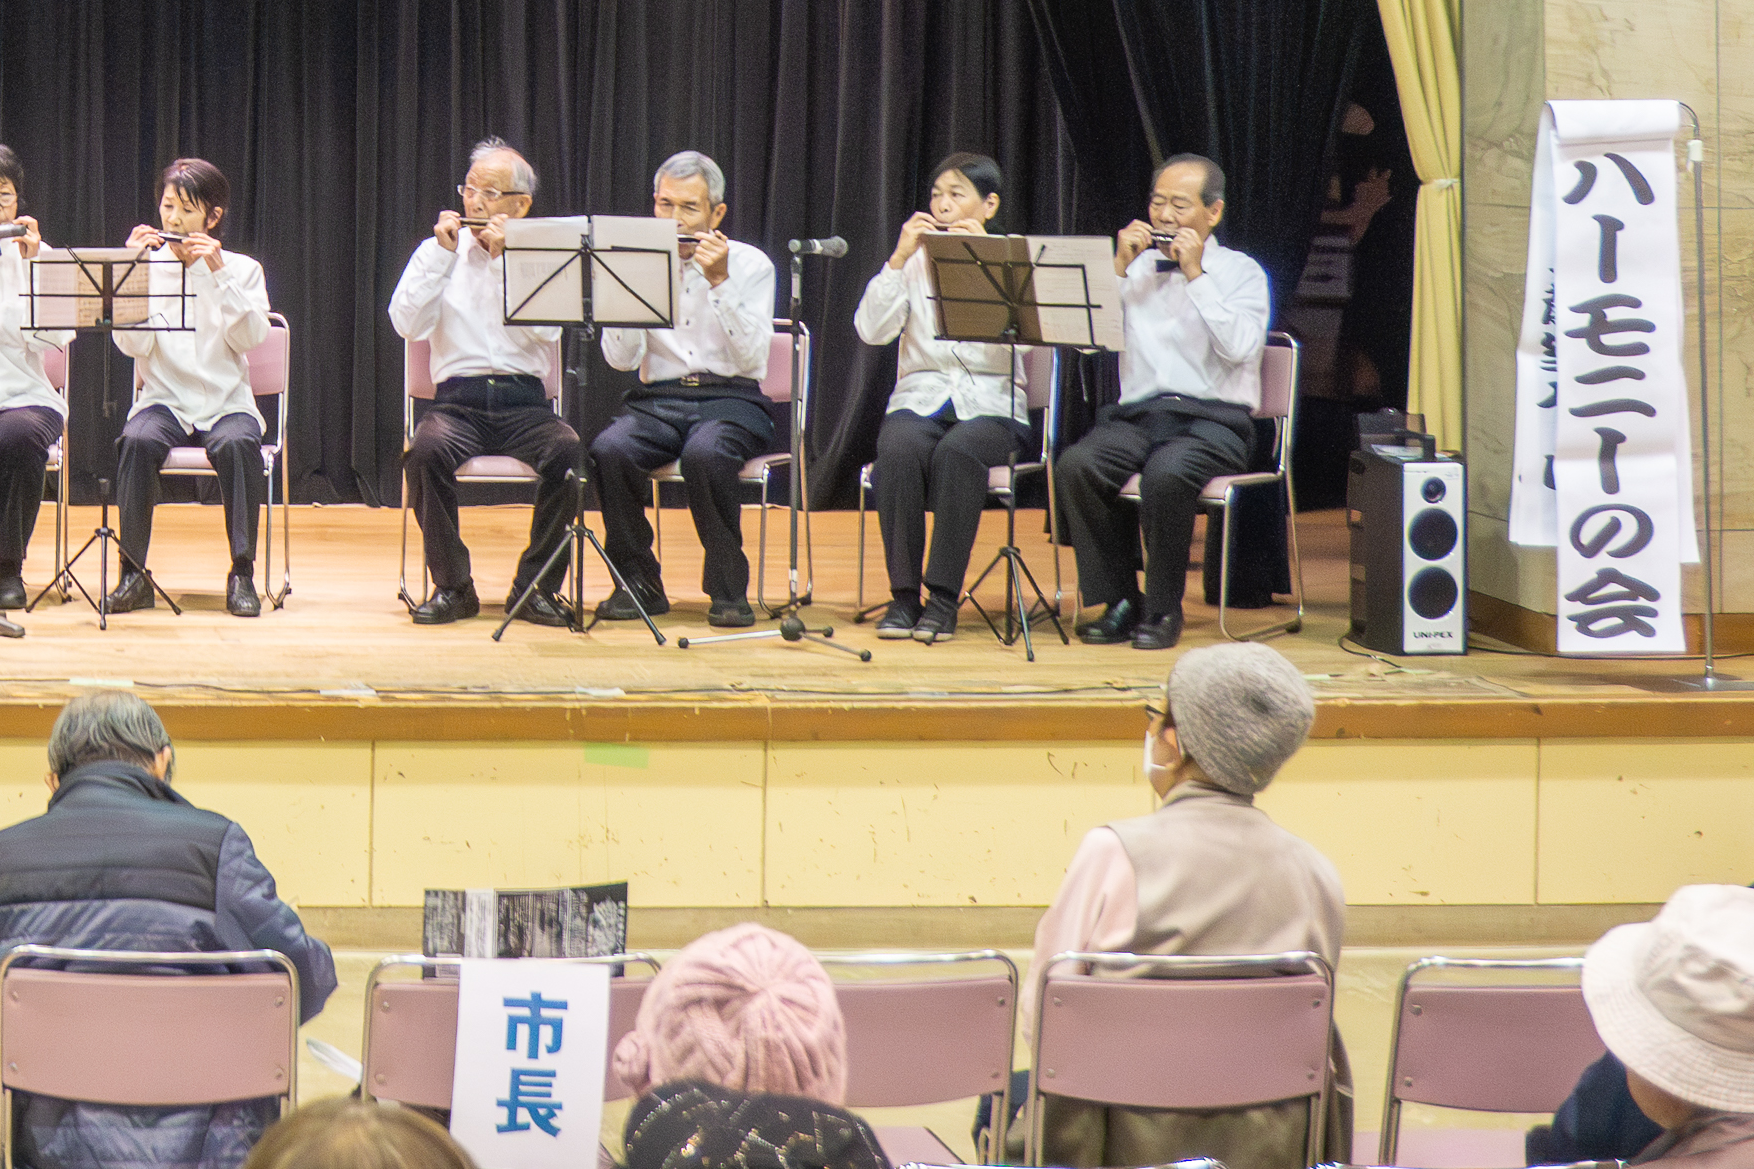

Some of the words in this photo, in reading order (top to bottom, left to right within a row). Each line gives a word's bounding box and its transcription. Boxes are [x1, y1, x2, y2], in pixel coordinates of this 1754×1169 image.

[1562, 152, 1661, 638] ハーモニーの会
[495, 991, 568, 1138] 市長
